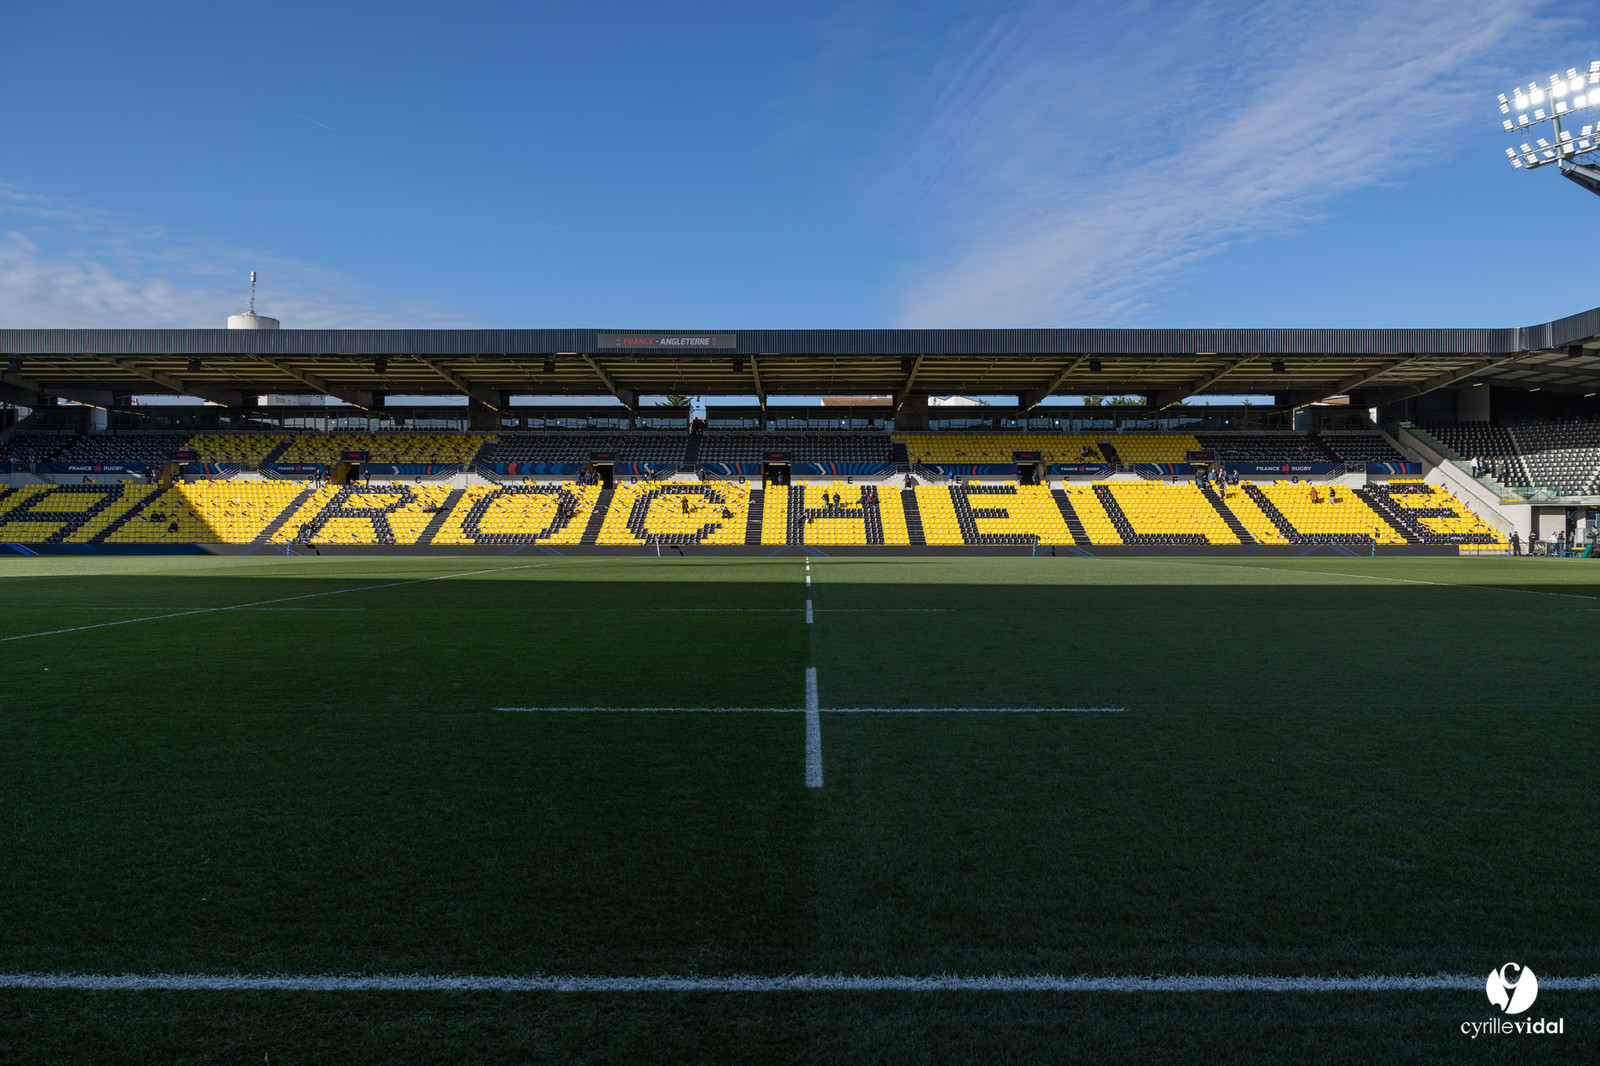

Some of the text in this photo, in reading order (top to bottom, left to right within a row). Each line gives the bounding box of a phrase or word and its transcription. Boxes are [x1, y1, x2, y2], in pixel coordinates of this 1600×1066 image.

[623, 337, 654, 345] FRANCE
[660, 337, 710, 345] ANGLETERRE
[415, 476, 421, 484] C
[631, 476, 637, 484] D
[739, 476, 745, 484] D
[847, 476, 853, 484] E
[956, 476, 962, 484] E
[1172, 476, 1178, 484] F
[1292, 476, 1299, 484] G
[296, 484, 1498, 544] ROCHELLE
